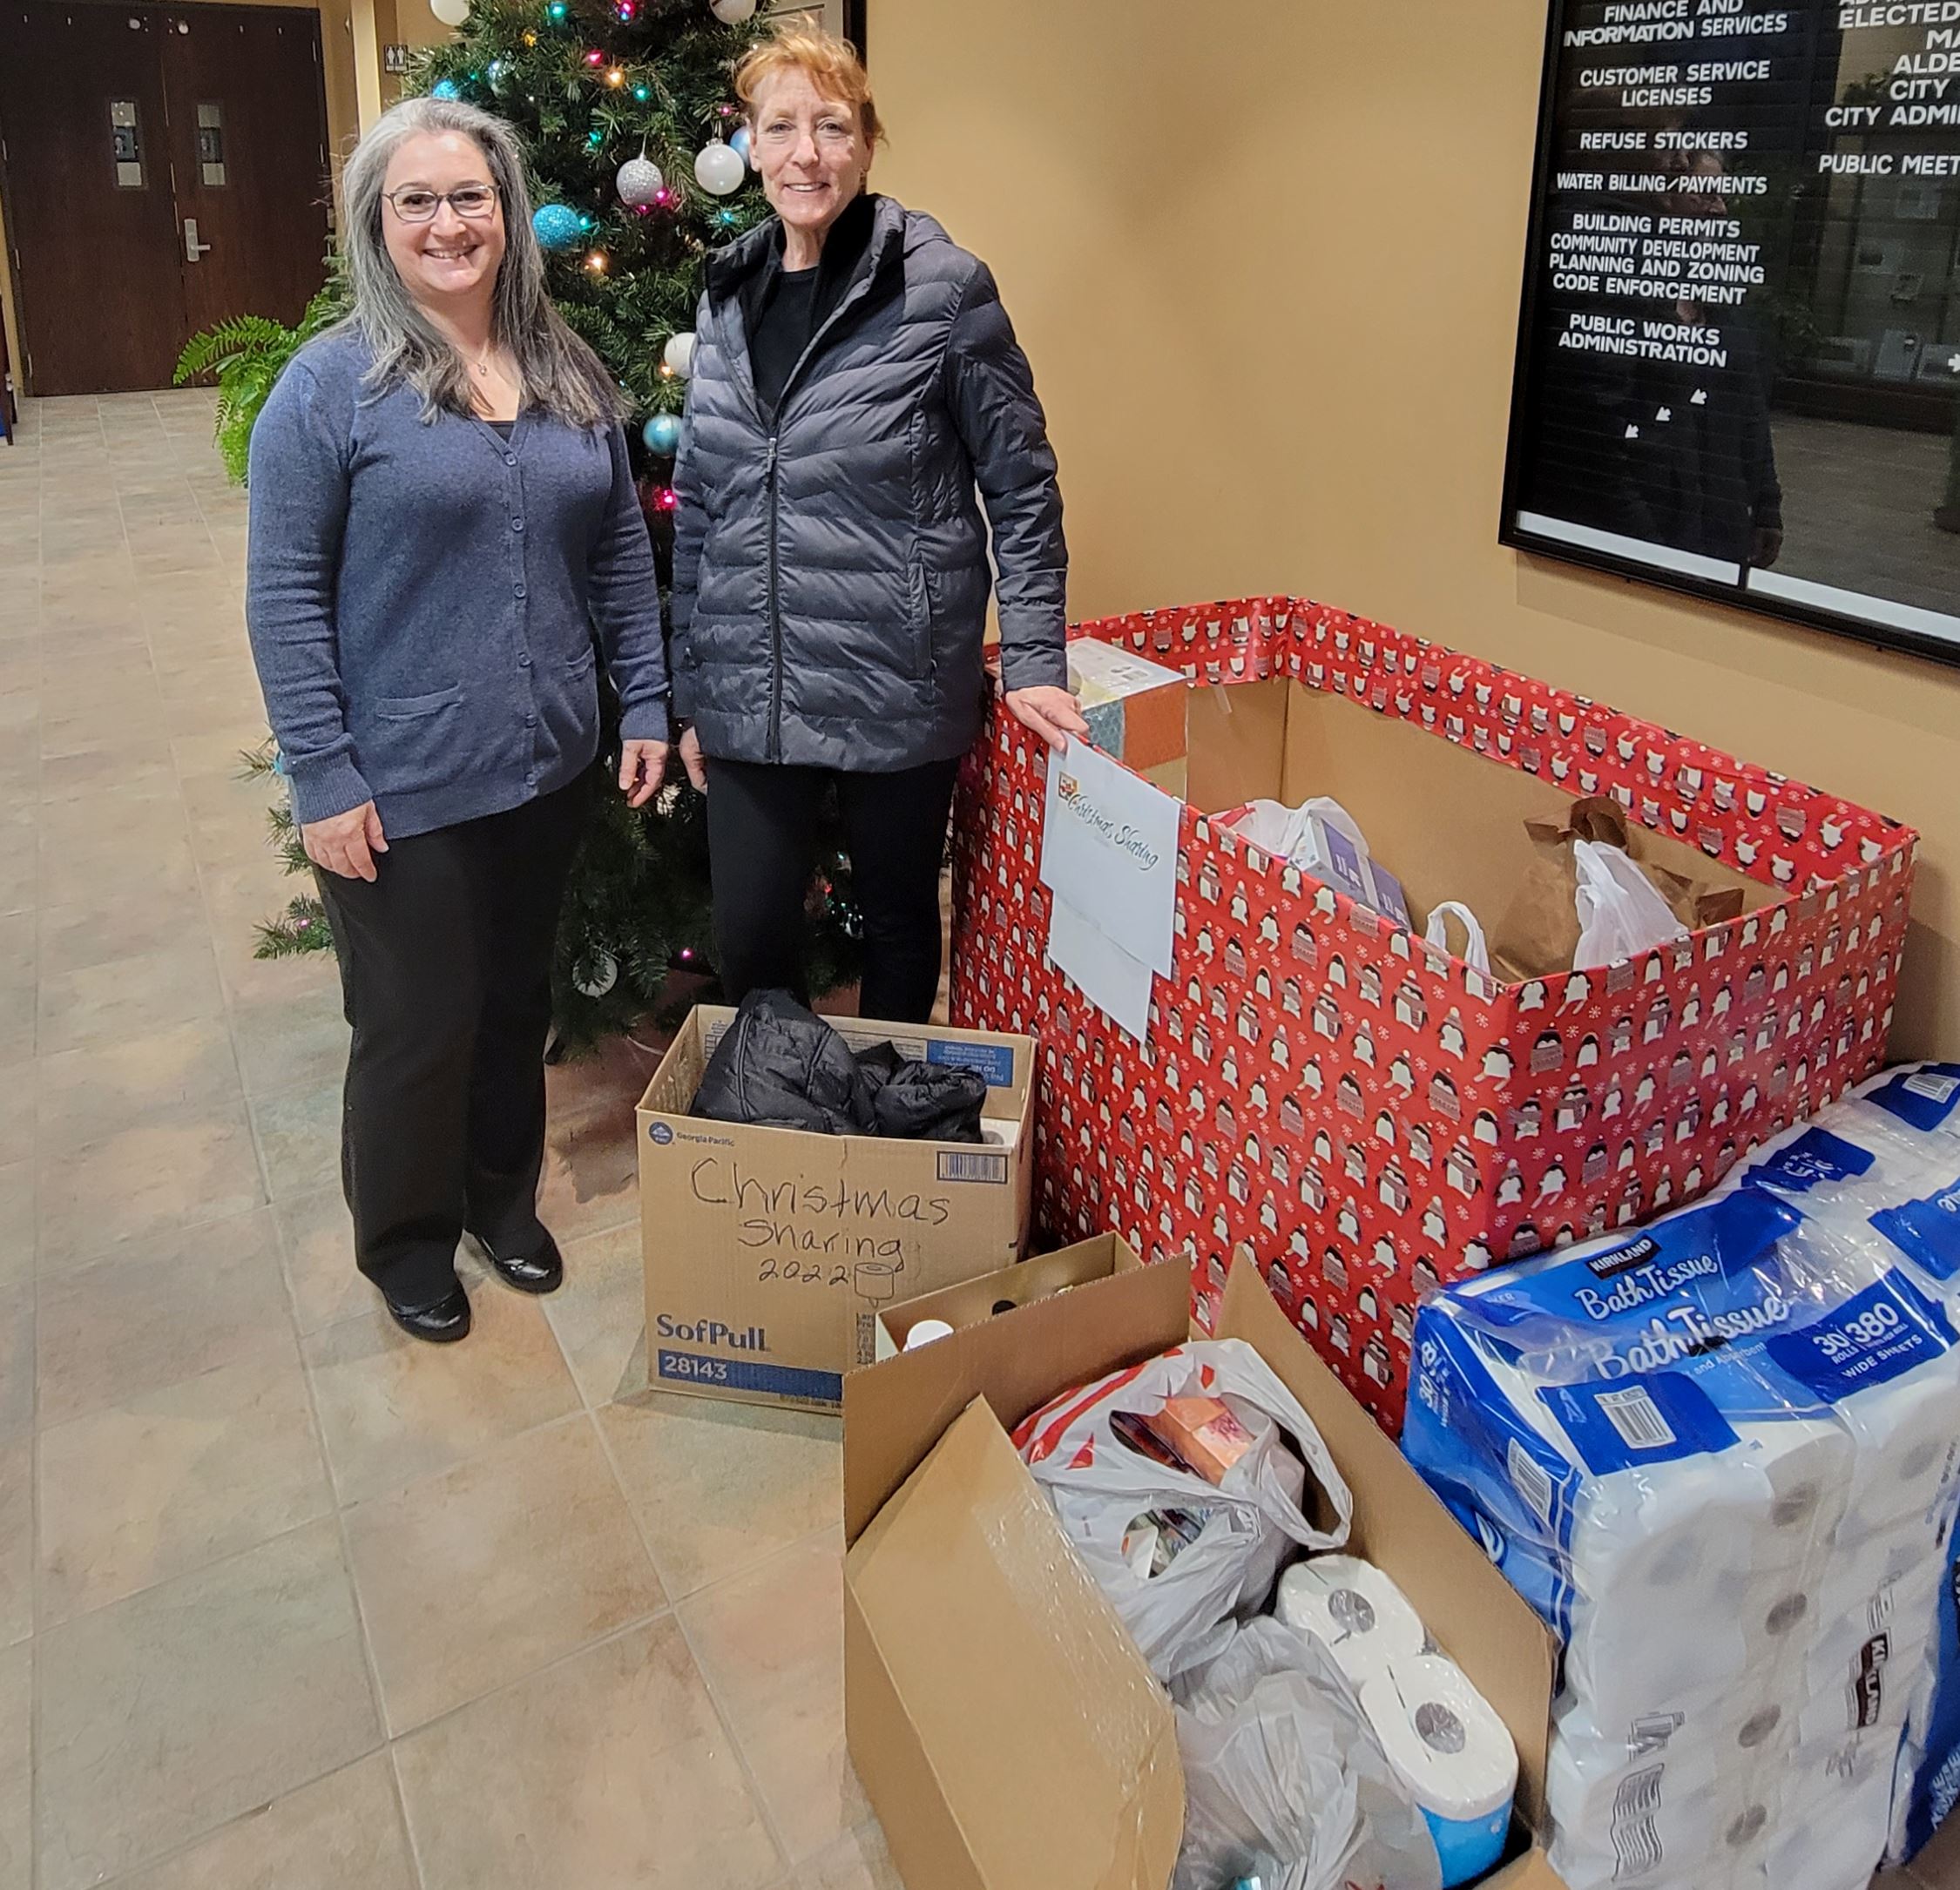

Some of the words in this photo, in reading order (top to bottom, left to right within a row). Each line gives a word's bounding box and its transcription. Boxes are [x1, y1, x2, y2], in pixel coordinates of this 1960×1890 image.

[1604, 0, 1689, 23] FINANCE
[1696, 0, 1744, 16] AND
[1838, 1, 1960, 29] ELECTED
[1563, 20, 1694, 47] INFORMATION
[1700, 13, 1788, 37] SERVICES
[1579, 65, 1679, 87] CUSTOMER
[1686, 60, 1771, 82] SERVICE
[1621, 87, 1713, 107] LICENSES
[1889, 78, 1950, 101] CITY
[1824, 105, 1882, 127] CITY
[1889, 104, 1960, 125] ADMI
[1579, 132, 1646, 150] REFUSE
[1653, 131, 1748, 150] STICKERS
[1818, 154, 1894, 174] PUBLIC
[1556, 172, 1604, 191] WATER
[1572, 213, 1652, 234] BUILDING
[1658, 218, 1741, 239] PERMITS
[1550, 233, 1638, 256] COMMUNITY
[1642, 239, 1761, 263] DEVELOPMENT
[1549, 253, 1635, 275] PLANNING
[1639, 258, 1681, 278] AND
[1686, 261, 1766, 284] ZONING
[1552, 273, 1600, 293] CODE
[1605, 277, 1747, 305] ENFORCEMENT
[1569, 313, 1636, 336] PUBLIC
[1642, 321, 1721, 346] WORKS
[1558, 331, 1727, 368] ADMINISTRATION
[1113, 824, 1159, 871] Sharing
[676, 1131, 707, 1144] Georgia
[691, 1157, 950, 1225] Christmas
[737, 1218, 906, 1272] Sharing
[1589, 1239, 1653, 1272] KIRKLAND
[758, 1259, 849, 1286] 2022
[656, 1313, 766, 1352] SofPull
[1812, 1333, 1851, 1356] 30
[1845, 1302, 1899, 1343] 380
[664, 1354, 728, 1380] 28143
[1830, 1346, 1860, 1366] ROLLS
[1841, 1356, 1879, 1379] WIDE
[1878, 1333, 1924, 1360] SHEETS
